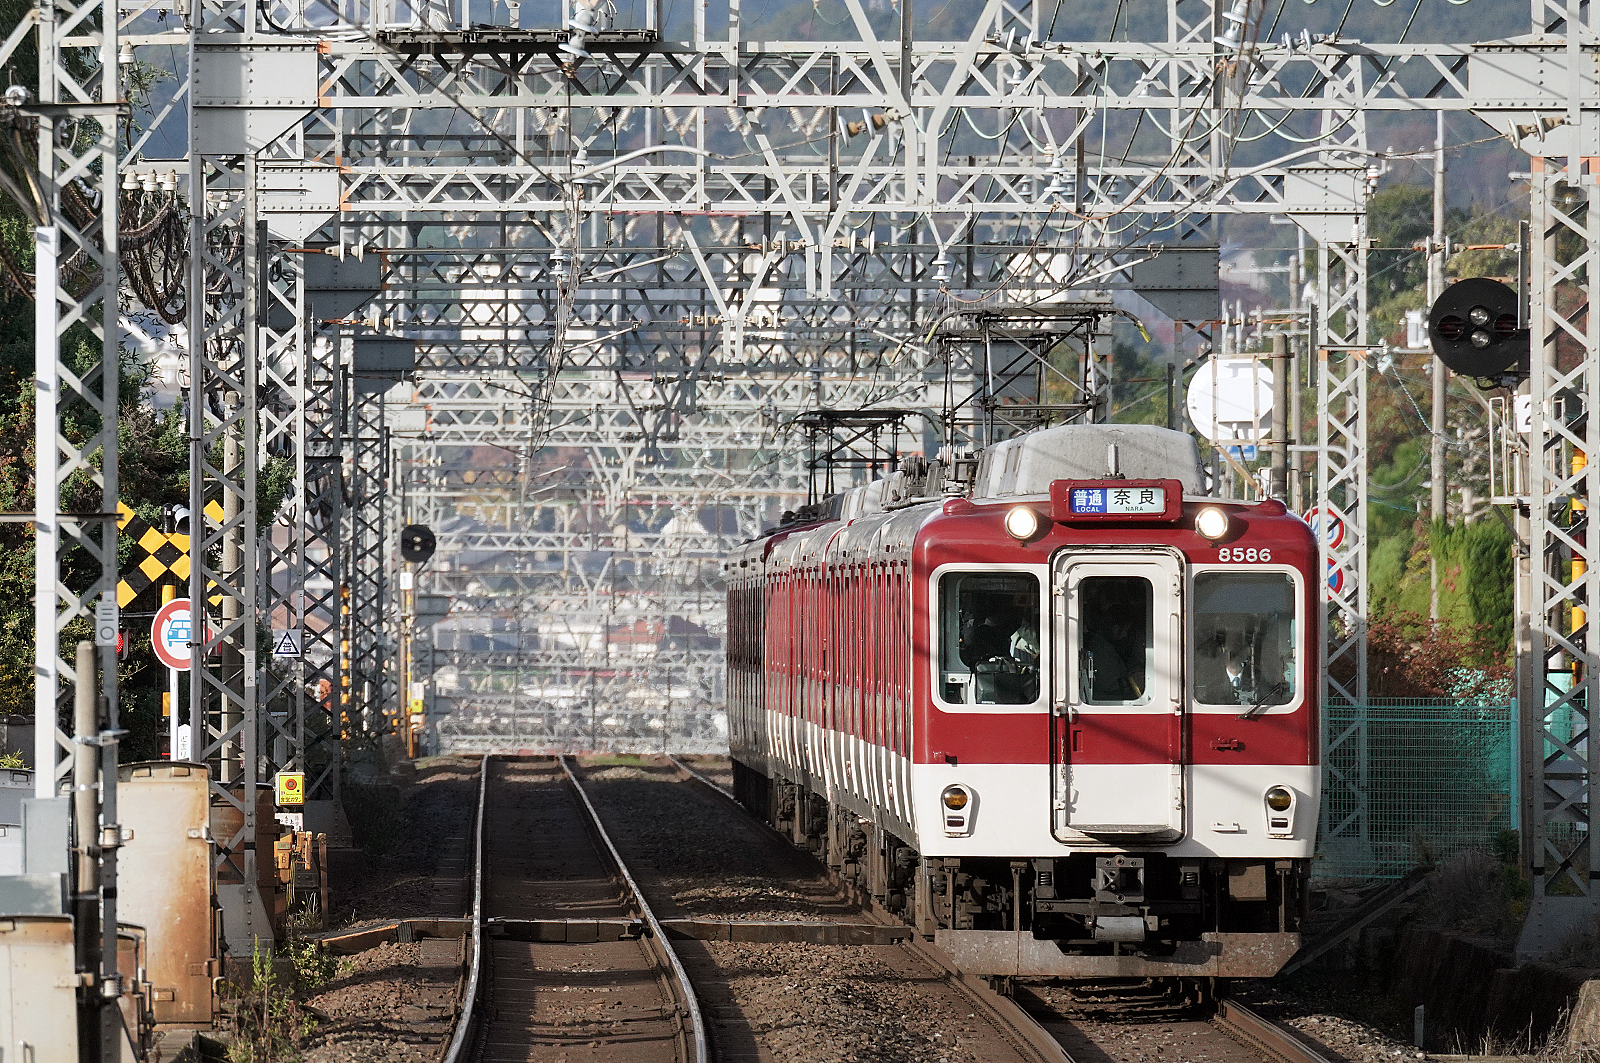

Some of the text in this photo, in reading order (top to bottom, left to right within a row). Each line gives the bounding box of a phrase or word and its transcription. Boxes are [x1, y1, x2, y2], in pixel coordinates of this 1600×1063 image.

[1074, 489, 1102, 506] 普通
[1114, 489, 1155, 505] 奈良
[1218, 547, 1271, 562] 8586
